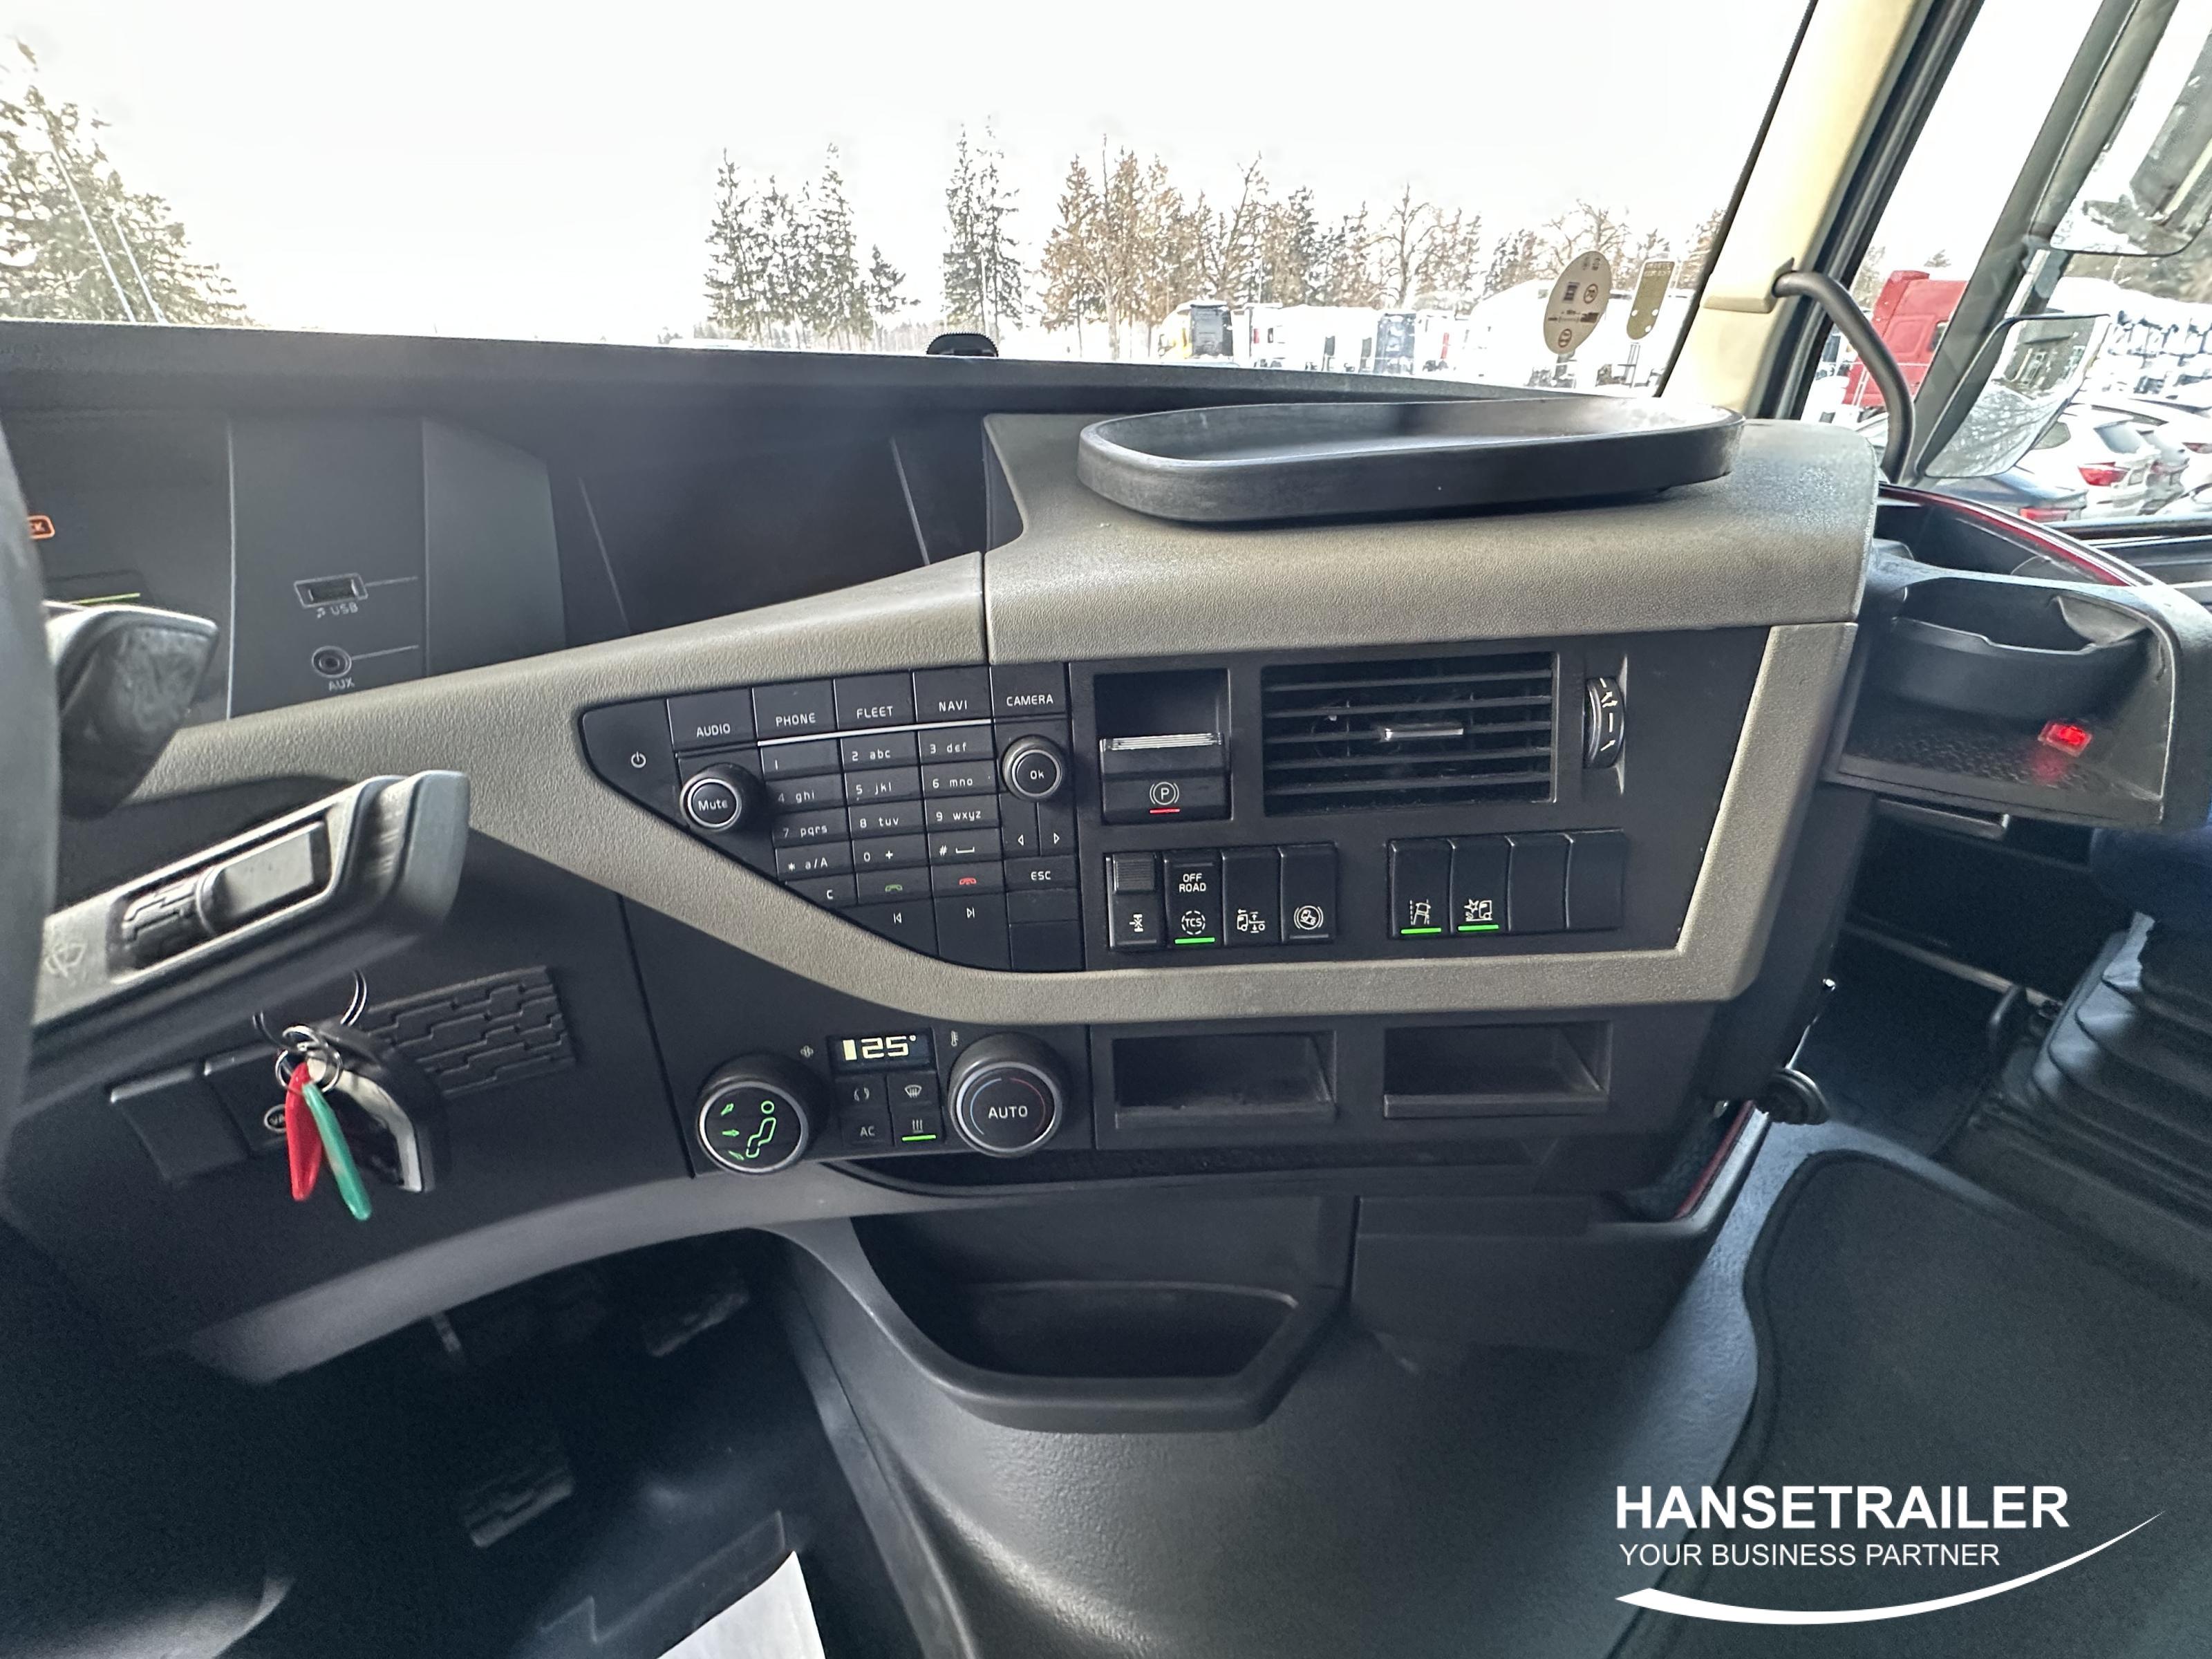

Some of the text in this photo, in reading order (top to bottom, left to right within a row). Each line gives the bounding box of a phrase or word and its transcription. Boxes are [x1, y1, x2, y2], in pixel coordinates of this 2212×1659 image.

[330, 601, 359, 616] USB
[328, 677, 355, 692] AUX
[938, 700, 968, 712] NAVI
[1006, 694, 1053, 706] CAMERA
[856, 705, 893, 720] FLEET
[776, 712, 816, 727] PHONE
[696, 723, 731, 738] AUDIO
[930, 742, 966, 754] 3 def
[852, 749, 891, 762] 2 abc
[856, 782, 892, 796] 5 jkl
[932, 778, 973, 789] 6 mno
[778, 789, 815, 803] 4 ghi
[697, 798, 728, 812] Mute
[859, 816, 899, 829] 8 tuv
[936, 810, 981, 822] 9 wxyz
[783, 825, 827, 838] 7 pqrs
[1031, 870, 1051, 881] ESC
[1182, 872, 1203, 883] OFF
[1179, 882, 1207, 893] ROAD
[826, 889, 834, 900] C
[1184, 917, 1203, 928] TCS
[988, 1105, 1028, 1119] AUTO
[860, 1125, 875, 1137] AC
